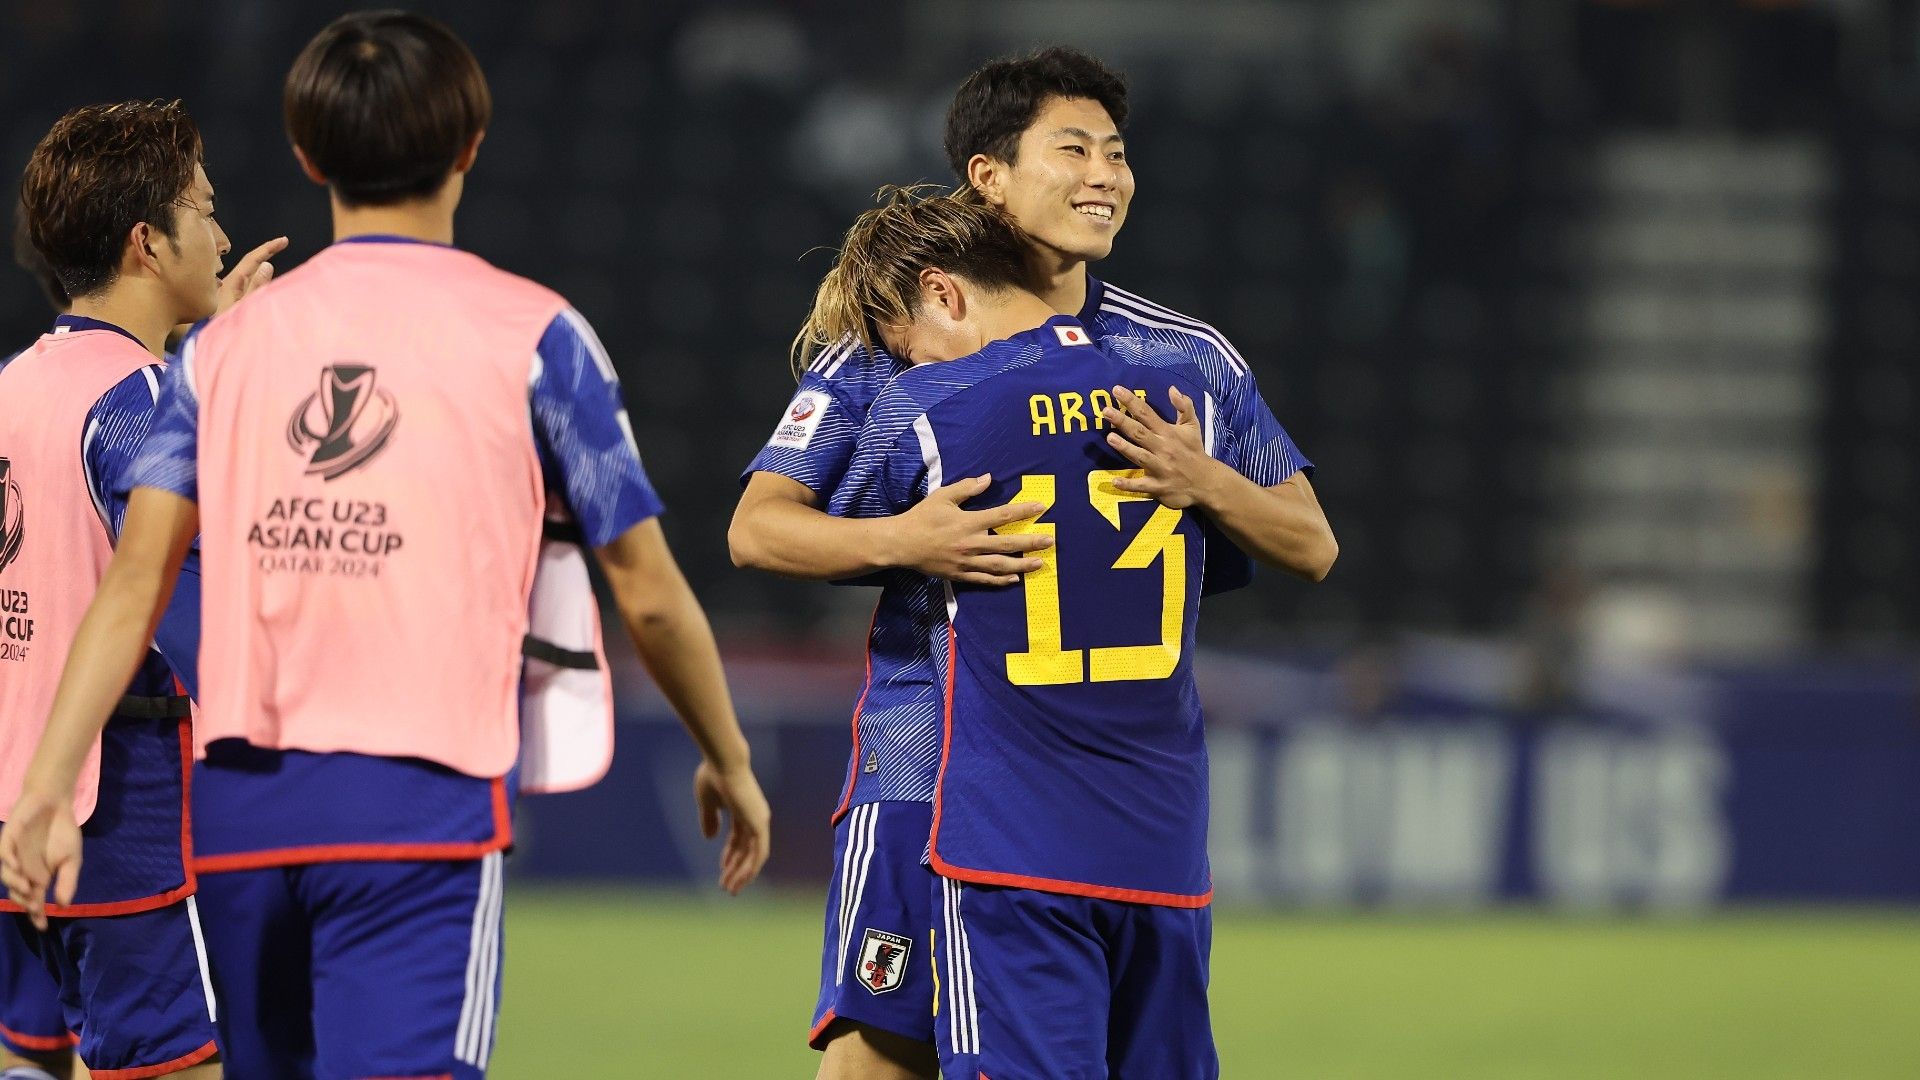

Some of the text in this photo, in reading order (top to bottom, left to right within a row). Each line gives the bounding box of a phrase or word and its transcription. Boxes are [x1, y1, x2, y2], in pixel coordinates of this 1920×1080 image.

[267, 498, 386, 526] AFC U23
[248, 522, 402, 555] ASIAN CUP
[259, 555, 379, 577] QATAR 2024
[991, 468, 1185, 686] 13
[876, 933, 901, 944] JAPAN
